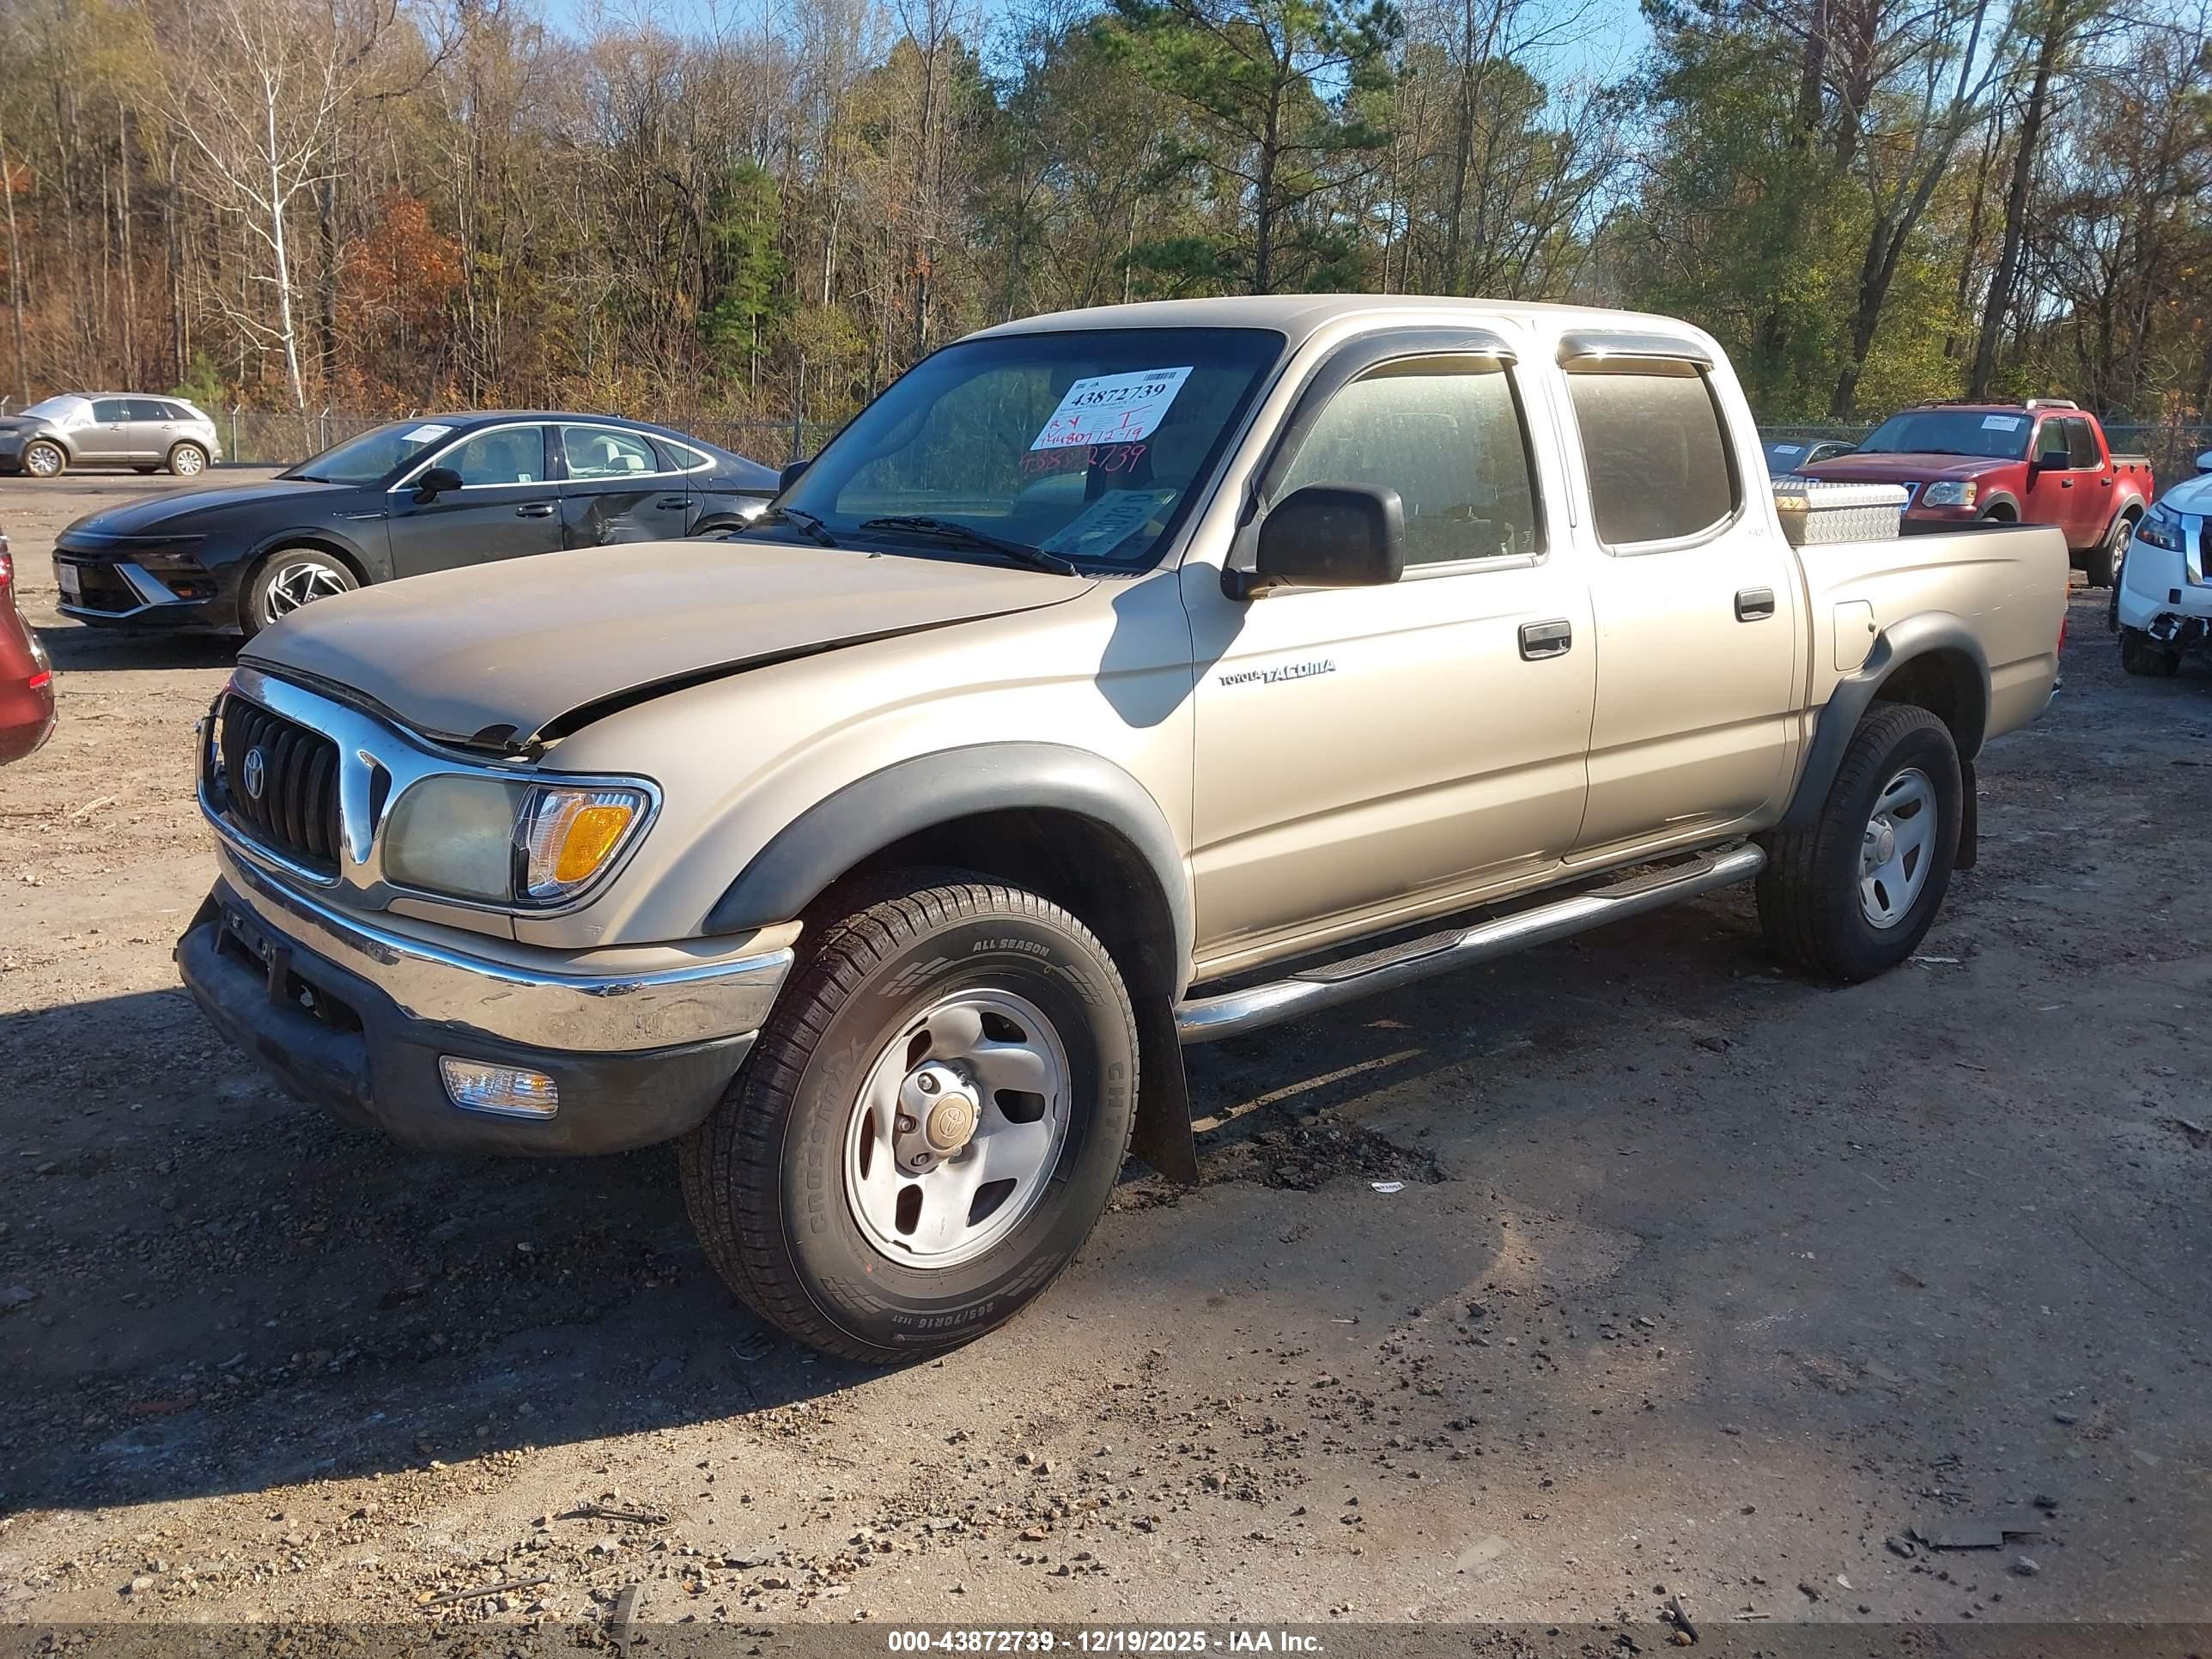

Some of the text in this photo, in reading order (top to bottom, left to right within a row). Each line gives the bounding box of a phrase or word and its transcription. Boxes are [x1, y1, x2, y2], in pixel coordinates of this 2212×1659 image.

[1072, 383, 1166, 406] 43872739
[1218, 659, 1337, 686] TOYOTA TACOMA
[972, 938, 1050, 957] ALL SEASON
[917, 1301, 994, 1329] 265/70R16
